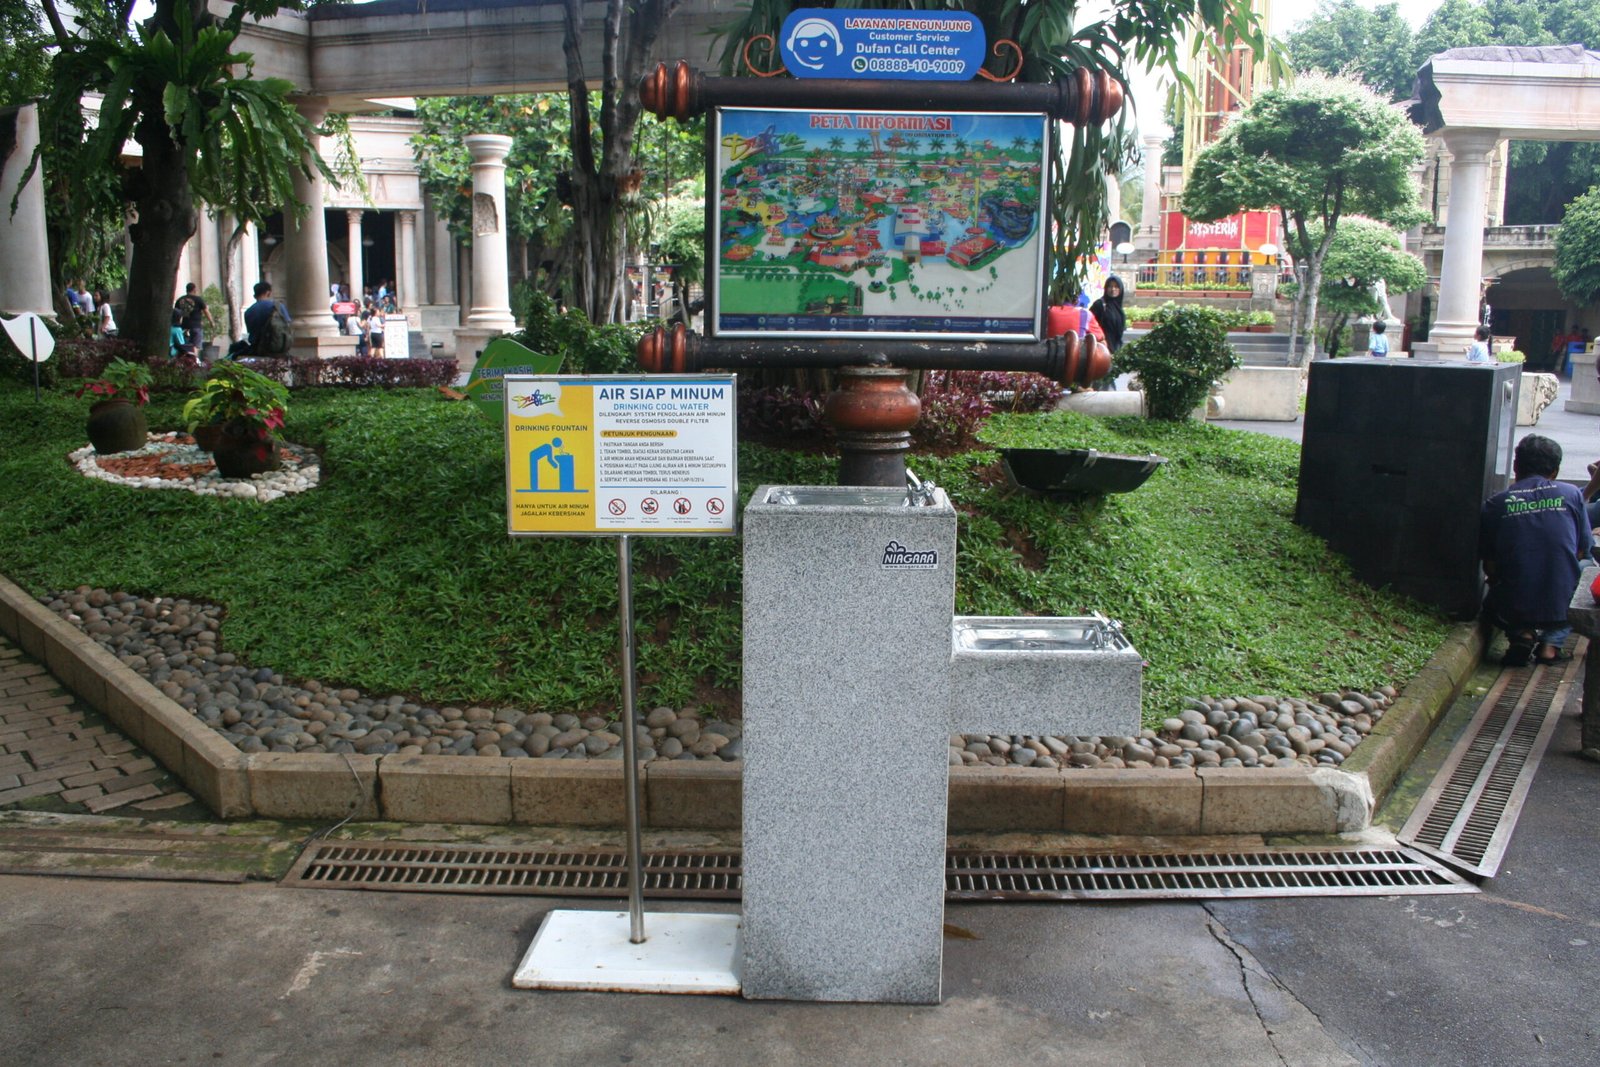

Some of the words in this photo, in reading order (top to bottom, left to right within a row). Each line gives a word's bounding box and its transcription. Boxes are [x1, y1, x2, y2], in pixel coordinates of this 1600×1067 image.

[845, 17, 896, 30] LAYANAN
[898, 18, 972, 32] PENGUNJUNG
[869, 32, 913, 41] Customer
[916, 33, 950, 42] Service
[856, 43, 890, 54] Dufan
[894, 43, 917, 55] Call
[922, 44, 960, 56] Center
[869, 59, 965, 74] 08888-10-9009
[810, 114, 853, 129] PETA
[856, 115, 952, 131] INFORMASI
[599, 388, 625, 400] AIR
[630, 388, 666, 400] SIAP
[671, 388, 724, 400] MINUM
[1507, 497, 1562, 512] NIAGARA
[884, 554, 934, 564] NIAGARA
